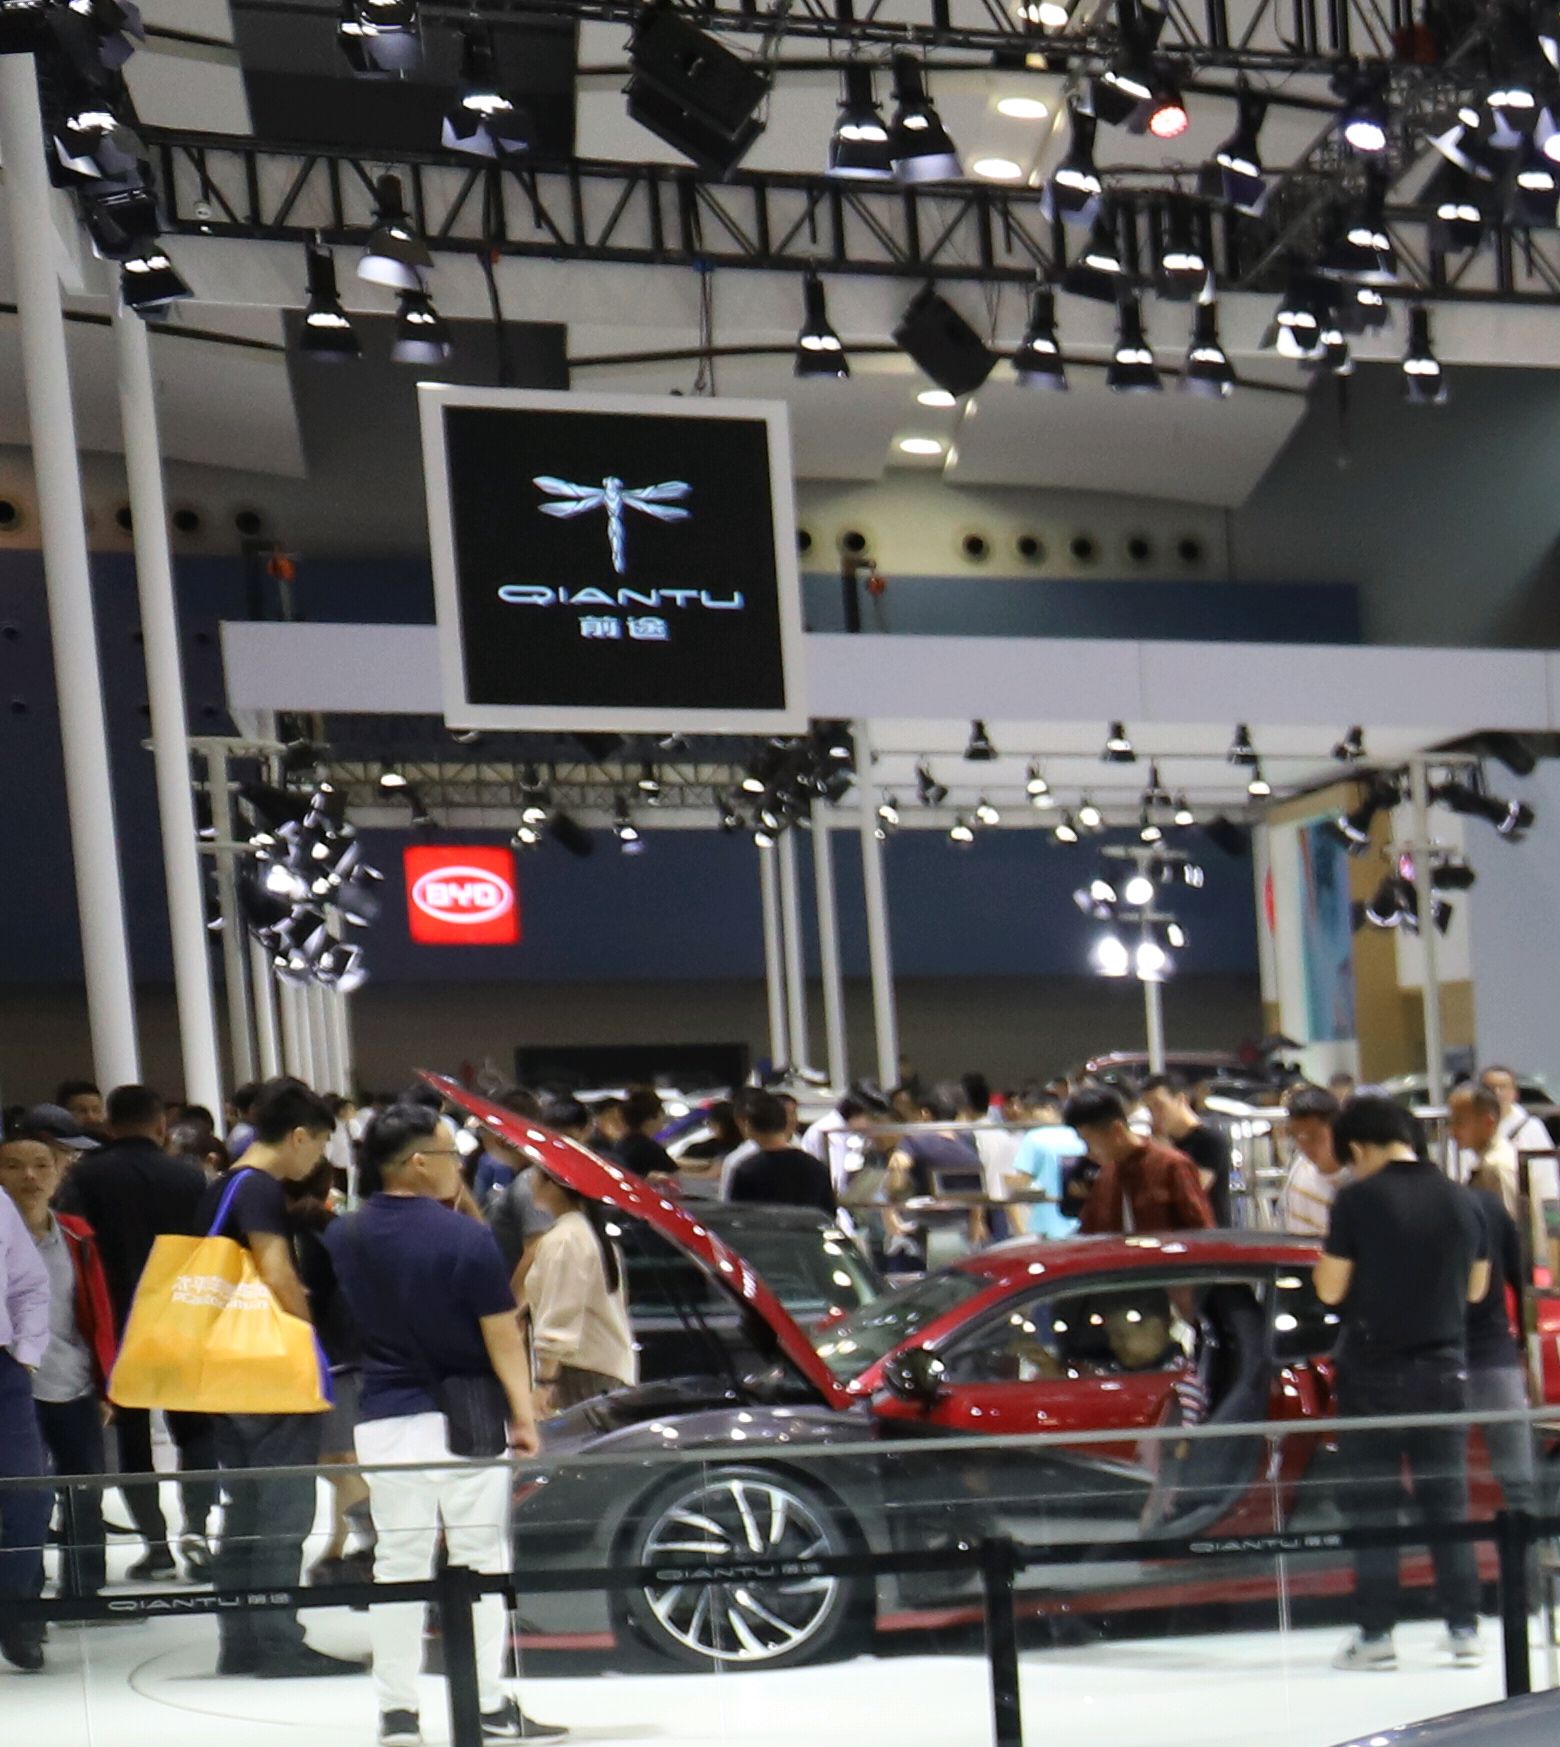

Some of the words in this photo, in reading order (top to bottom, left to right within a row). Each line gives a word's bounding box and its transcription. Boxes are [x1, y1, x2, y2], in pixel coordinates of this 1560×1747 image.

[497, 584, 745, 610] QIANTU
[578, 615, 671, 640] 前途
[425, 882, 499, 908] BYD
[1189, 1538, 1299, 1554] QIANTU
[656, 1565, 775, 1581] QIANTU
[107, 1596, 240, 1612] QIANTU
